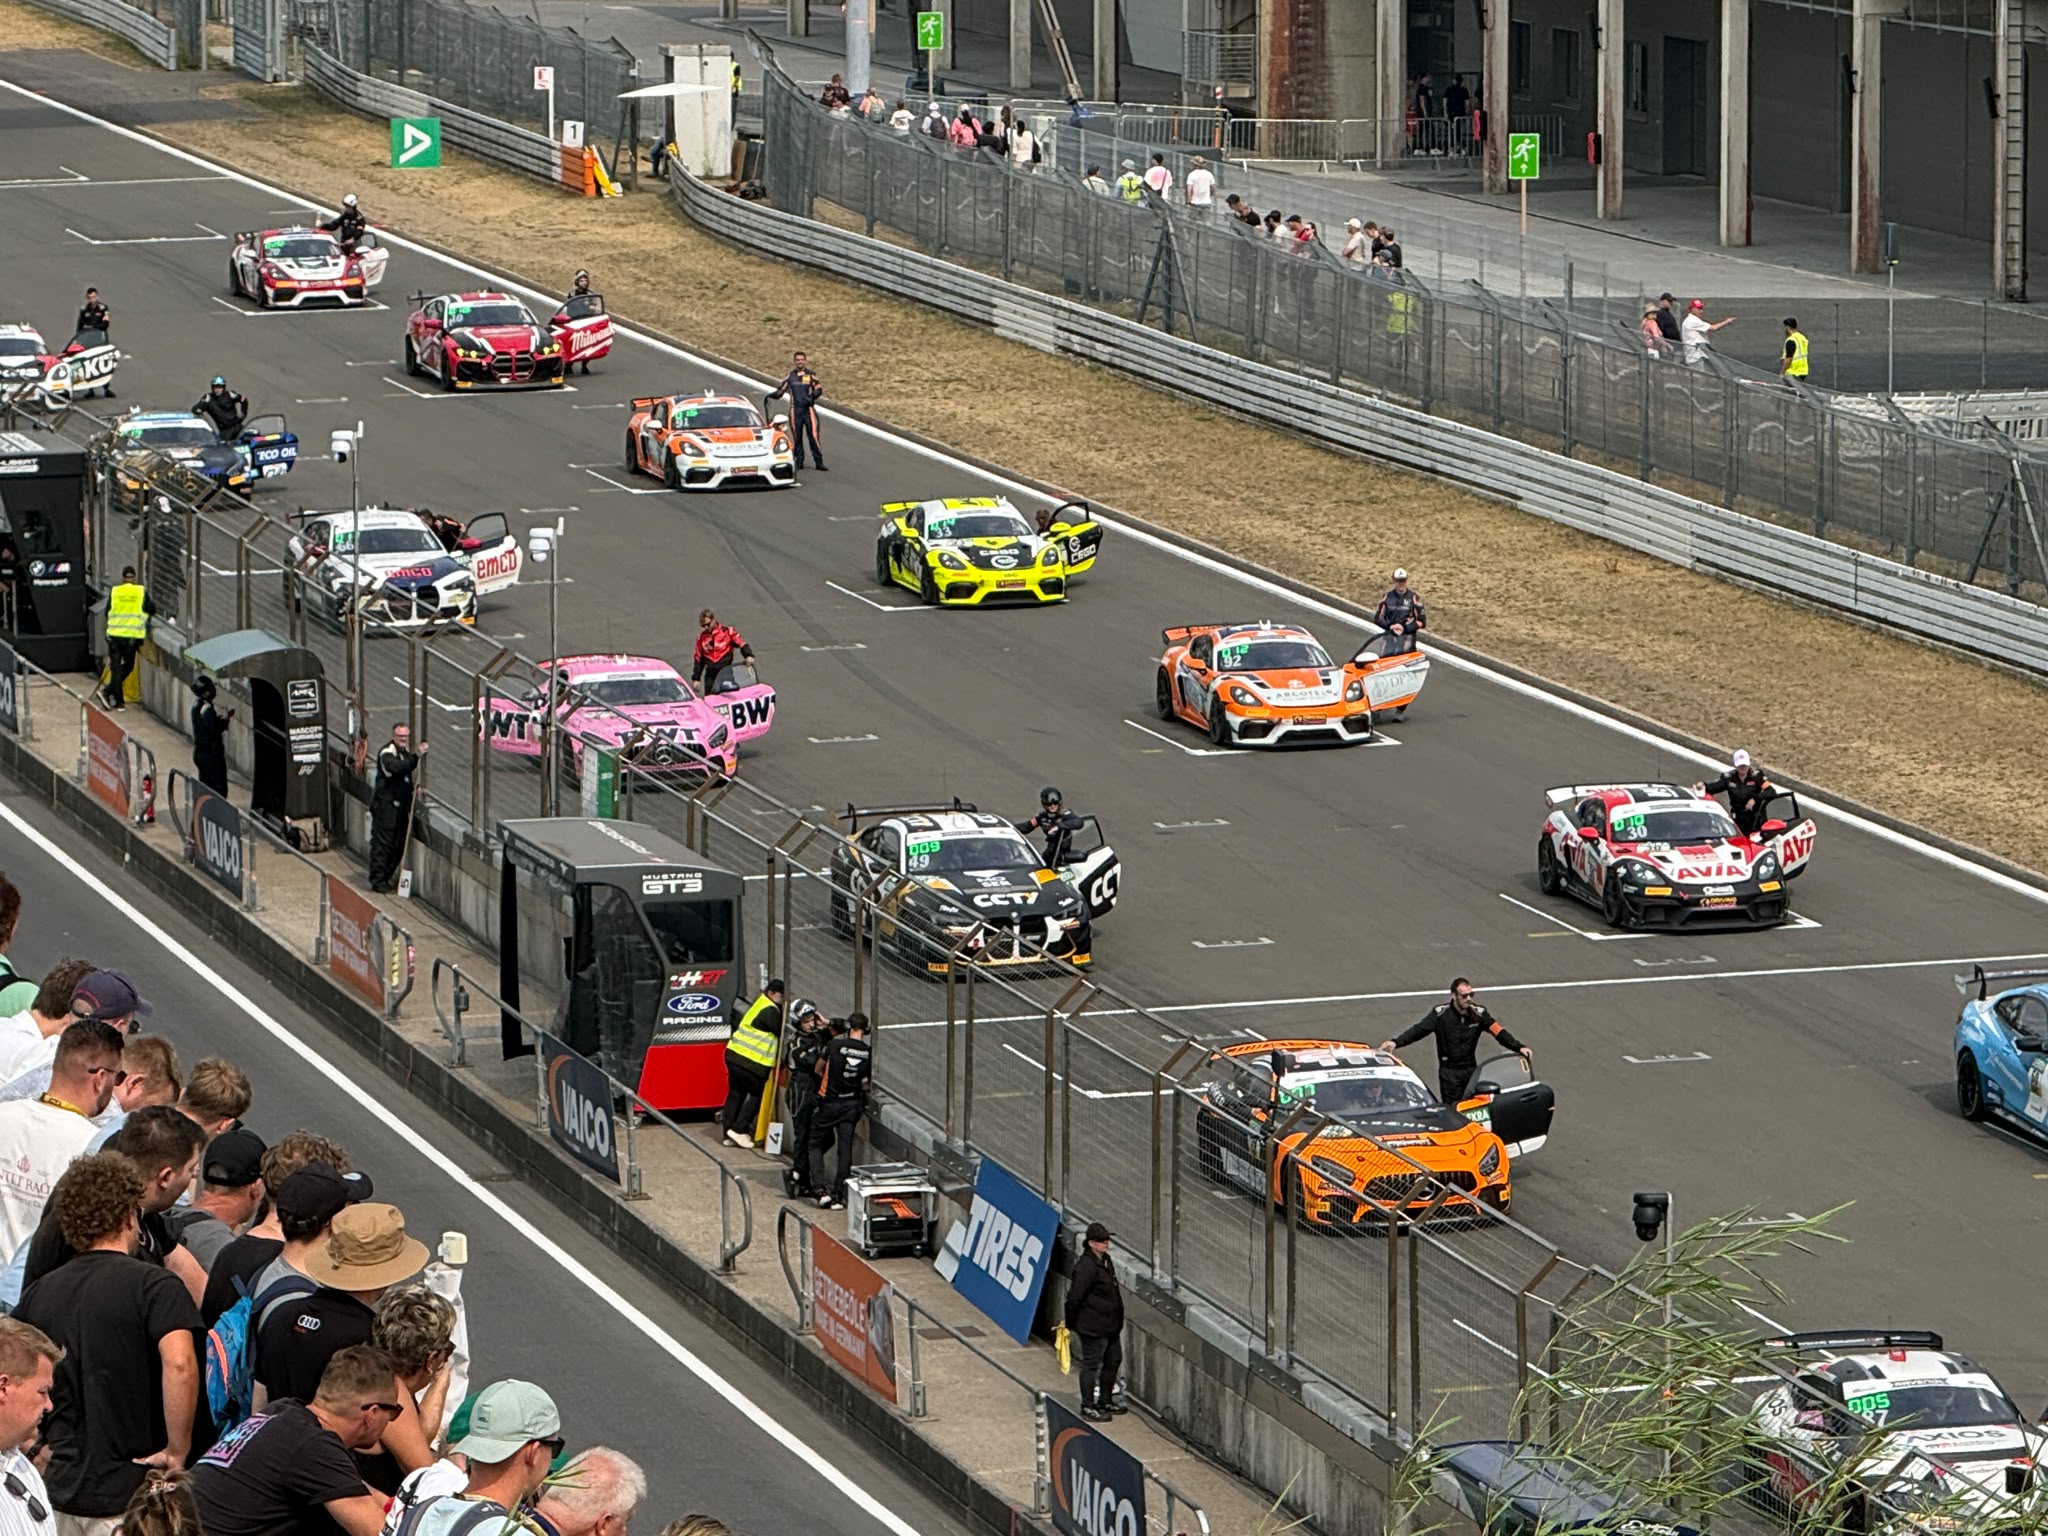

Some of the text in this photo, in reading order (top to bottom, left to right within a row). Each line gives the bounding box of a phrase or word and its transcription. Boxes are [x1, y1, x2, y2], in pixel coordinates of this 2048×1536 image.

[570, 124, 577, 139] 1
[936, 526, 952, 538] 33
[1070, 543, 1096, 564] CEGO
[1223, 655, 1242, 668] 92
[1627, 825, 1648, 840] 30
[202, 816, 240, 879] VAICO
[908, 854, 930, 868] 49
[642, 879, 703, 895] GT3
[677, 996, 710, 1011] Ford
[662, 1016, 723, 1025] RACING
[562, 1080, 609, 1157] VAICO
[769, 1131, 780, 1145] 4
[962, 1193, 1044, 1302] TIRES
[1071, 1458, 1138, 1536] VAICO
